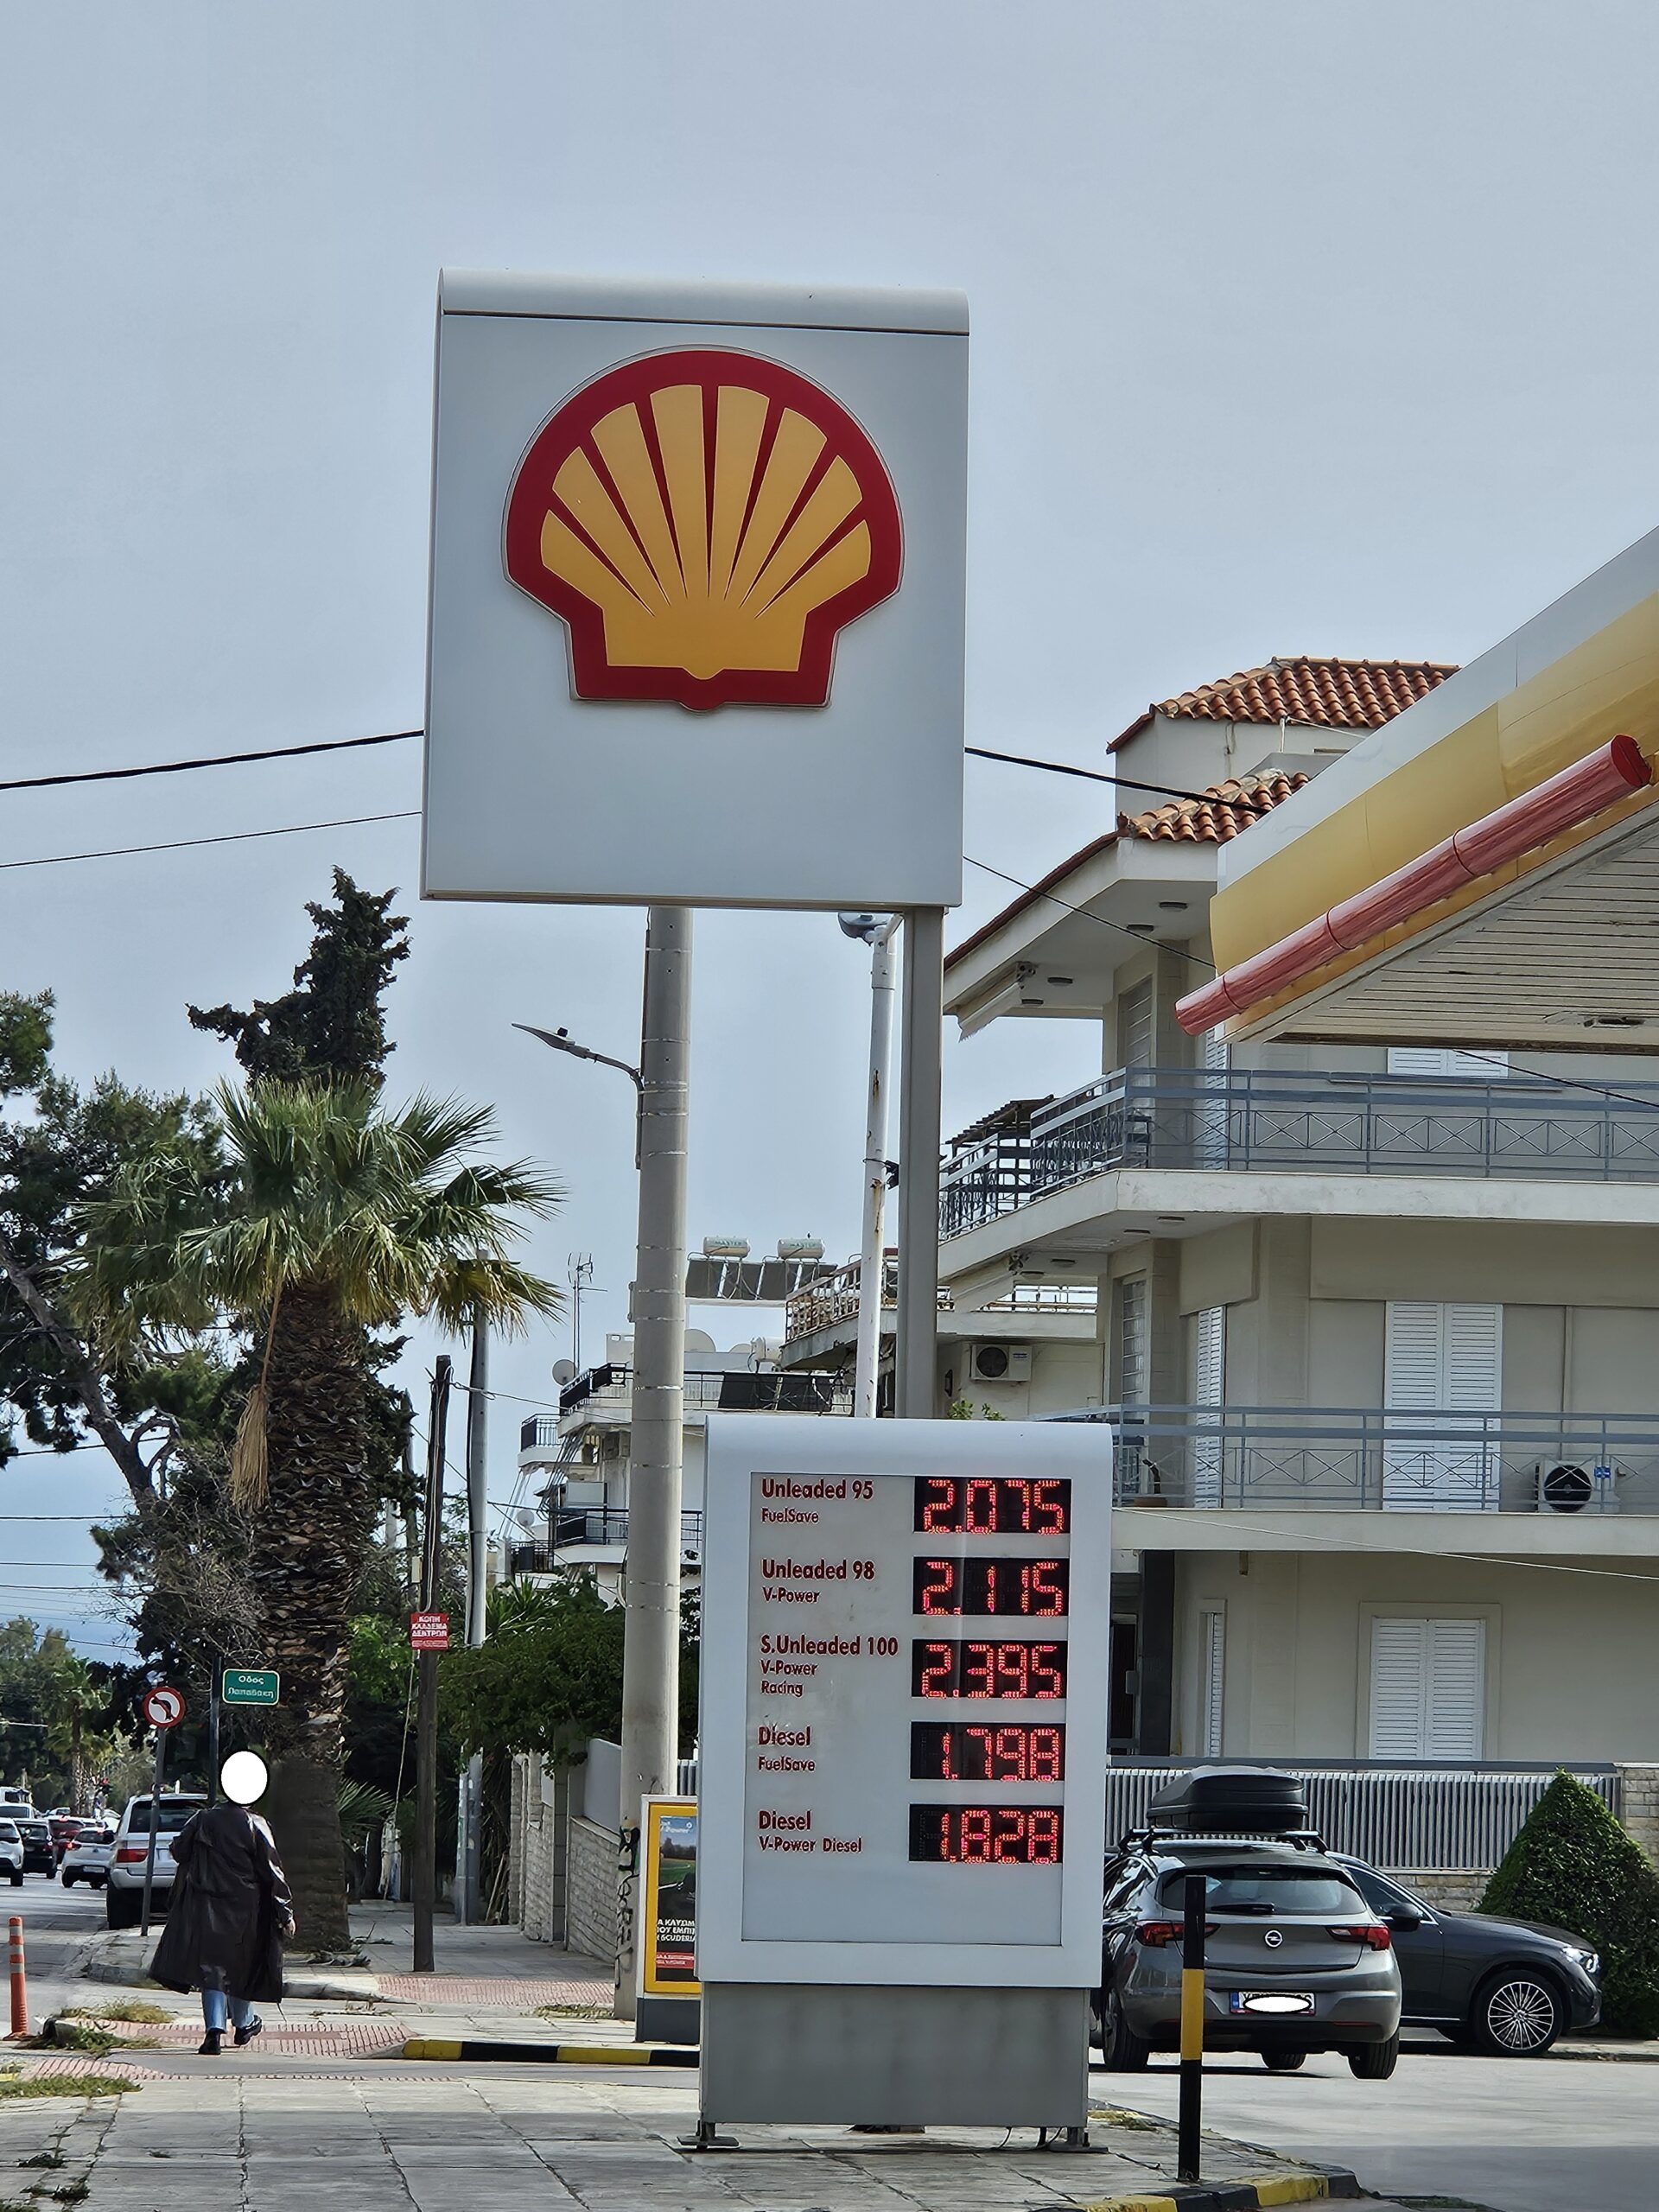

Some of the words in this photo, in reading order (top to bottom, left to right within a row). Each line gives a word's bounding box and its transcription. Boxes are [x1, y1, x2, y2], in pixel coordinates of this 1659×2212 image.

[761, 1478, 846, 1499] Unleaded
[852, 1479, 874, 1500] 95
[761, 1507, 819, 1523] FuelSave
[923, 1478, 1065, 1535] 2.075
[761, 1558, 847, 1580] Unleaded
[852, 1560, 875, 1580] 98
[762, 1586, 820, 1603] V-Power
[922, 1561, 1064, 1618] 2.115
[760, 1634, 861, 1656] S.Unleaded
[867, 1637, 899, 1656] 100
[760, 1659, 817, 1675] V-Power
[921, 1643, 1062, 1700] 2.395
[760, 1680, 804, 1698] Racing
[758, 1726, 811, 1747] Diesel
[758, 1755, 816, 1771] FuelSave
[941, 1727, 1060, 1783] 1.798
[759, 1809, 812, 1831] Diesel
[759, 1835, 816, 1853] V-Power
[823, 1836, 862, 1853] Diesel
[939, 1809, 1059, 1865] 1.828
